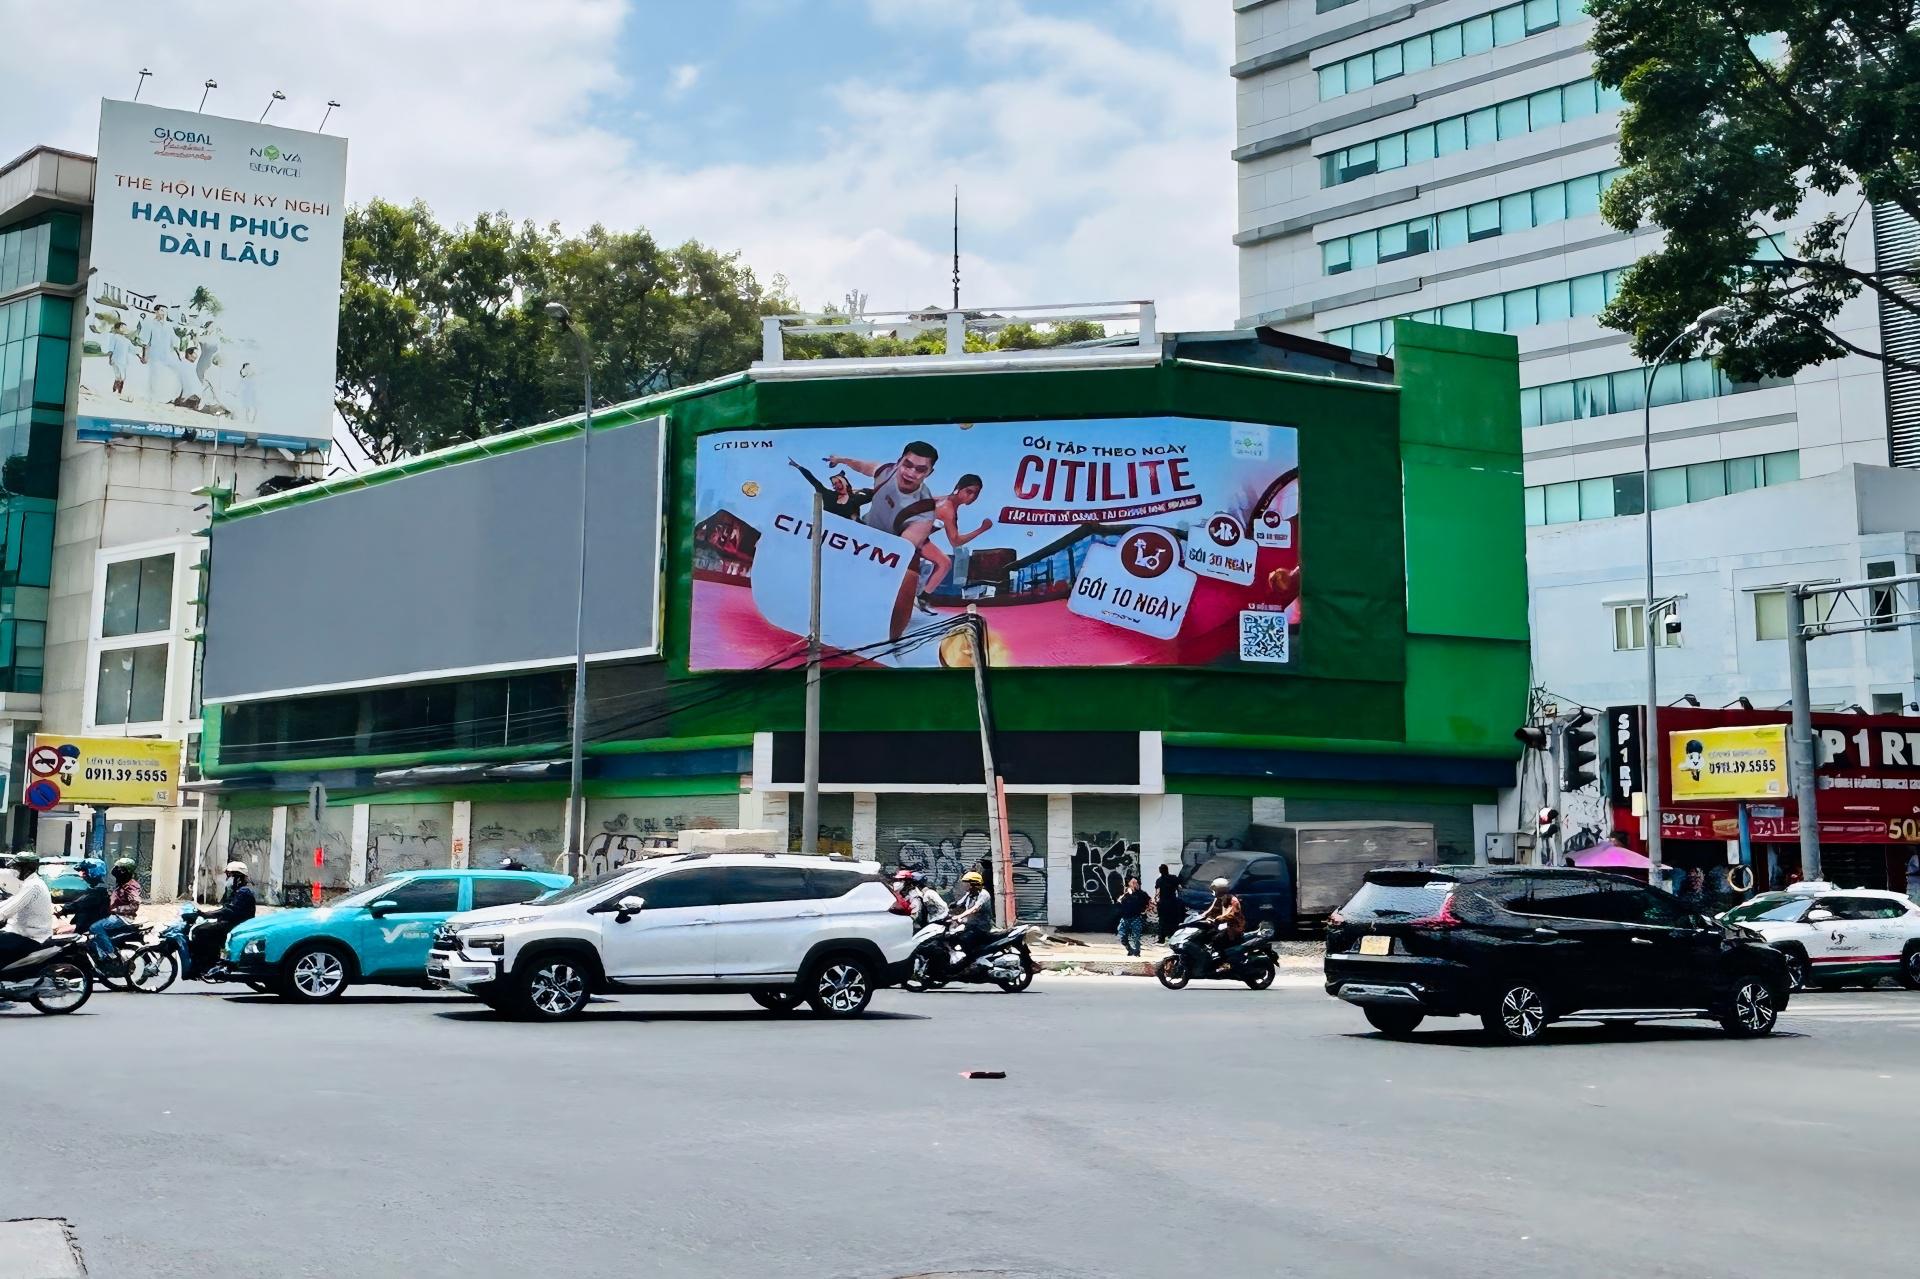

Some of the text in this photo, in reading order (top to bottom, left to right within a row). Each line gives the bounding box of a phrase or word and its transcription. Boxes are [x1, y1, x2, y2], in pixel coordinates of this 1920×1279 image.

[154, 127, 213, 146] GLOBAL
[131, 201, 310, 243] HẠNH PHÚC
[159, 232, 279, 267] DÀI LÂU
[1092, 446, 1137, 457] THEO
[1013, 454, 1196, 502] CITILITE
[774, 514, 901, 569] CITIGYM
[1208, 552, 1223, 567] 30
[1078, 576, 1108, 601] GÓI
[1112, 587, 1132, 608] 10
[1134, 592, 1182, 622] NGÀY
[85, 767, 167, 782] 0911.39.5555
